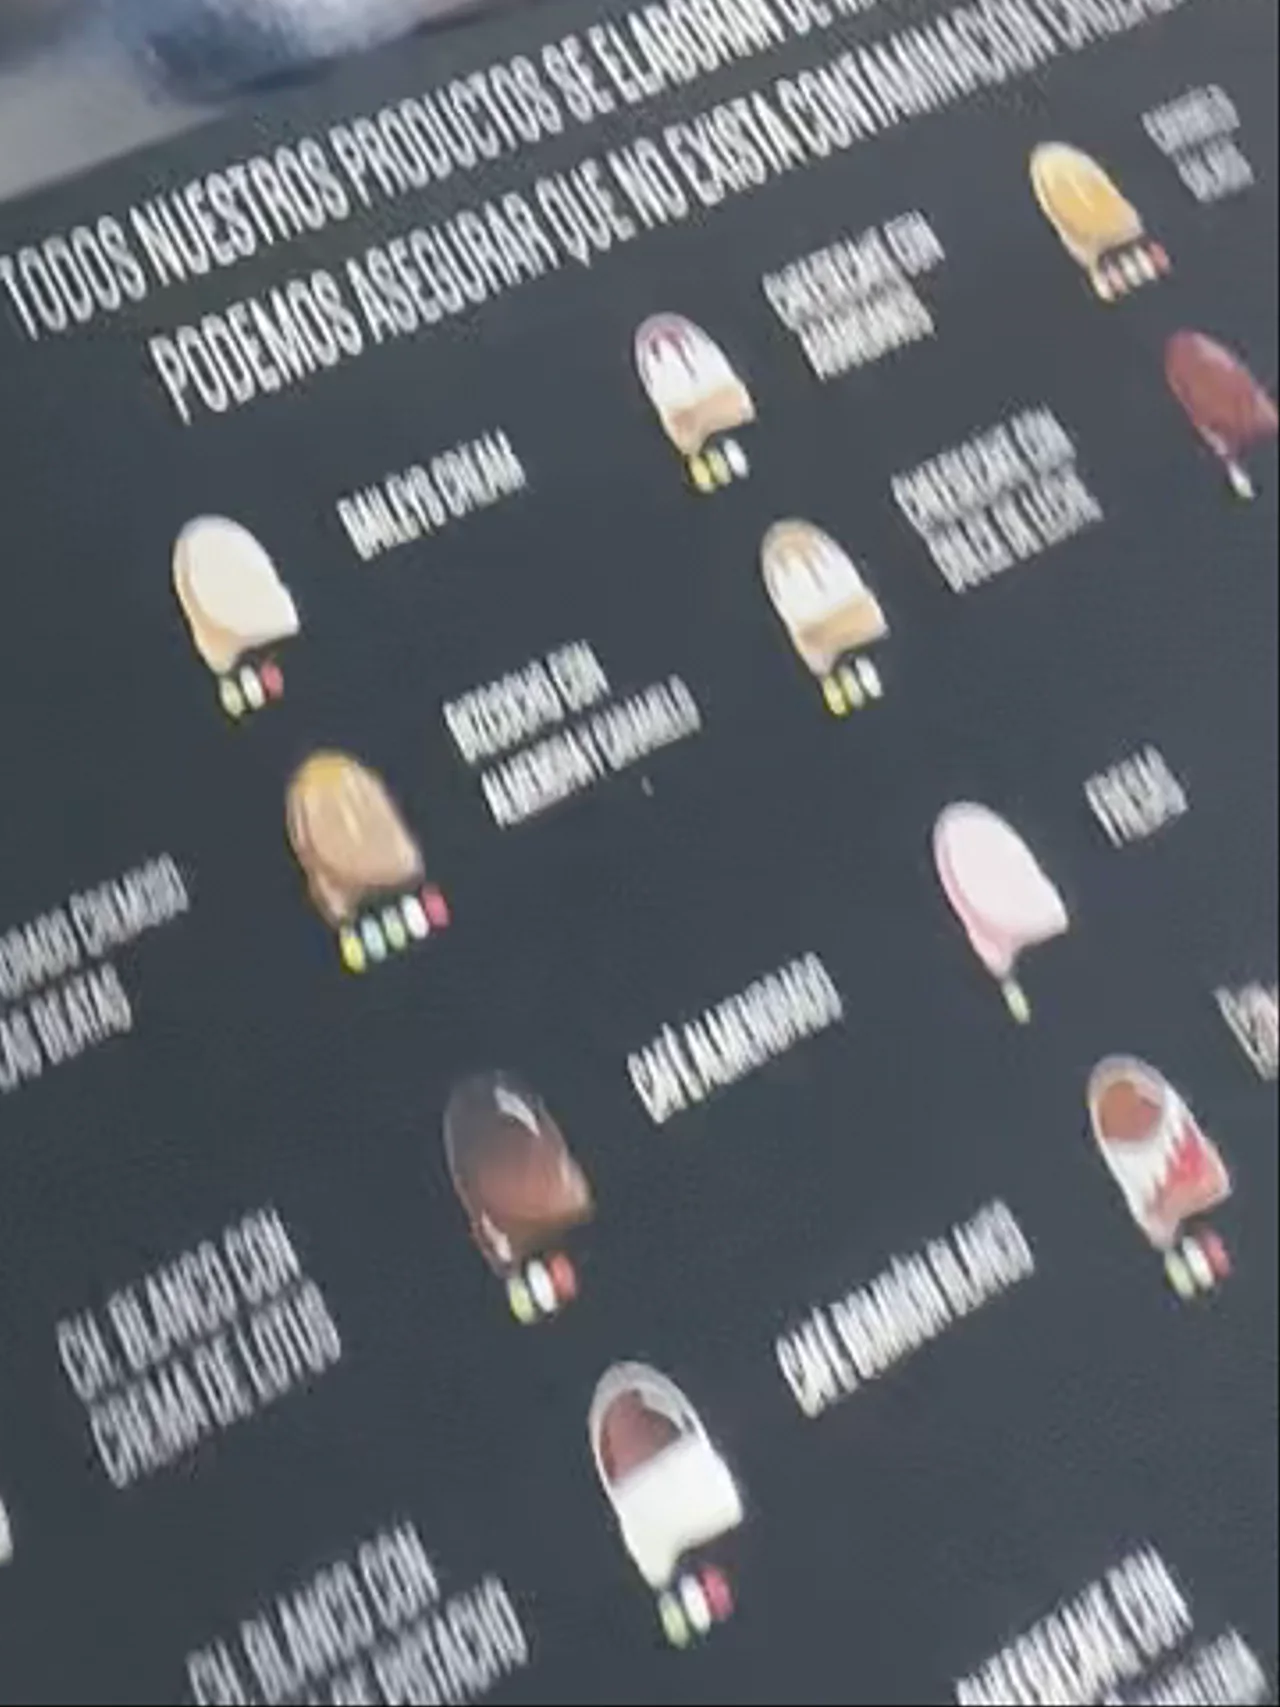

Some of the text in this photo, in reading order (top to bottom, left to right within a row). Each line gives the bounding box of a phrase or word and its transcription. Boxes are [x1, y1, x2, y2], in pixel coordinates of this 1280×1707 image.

[129, 136, 350, 287] NUESTROS
[331, 53, 542, 206] PRODUCTOS
[541, 24, 612, 135] SE
[147, 268, 363, 426] PODEMOS
[345, 193, 560, 344] ASEGURAR
[534, 159, 637, 269] QUE
[607, 130, 690, 232] NO
[663, 89, 812, 207] EXISTA
[337, 465, 446, 561] BAILEYS
[90, 1278, 342, 1489] CREMA DE LOTUS
[106, 1239, 238, 1373] BLANCO
[223, 1207, 301, 1304] CON
[241, 1559, 373, 1705] BLANCO
[357, 1520, 439, 1630] CON
